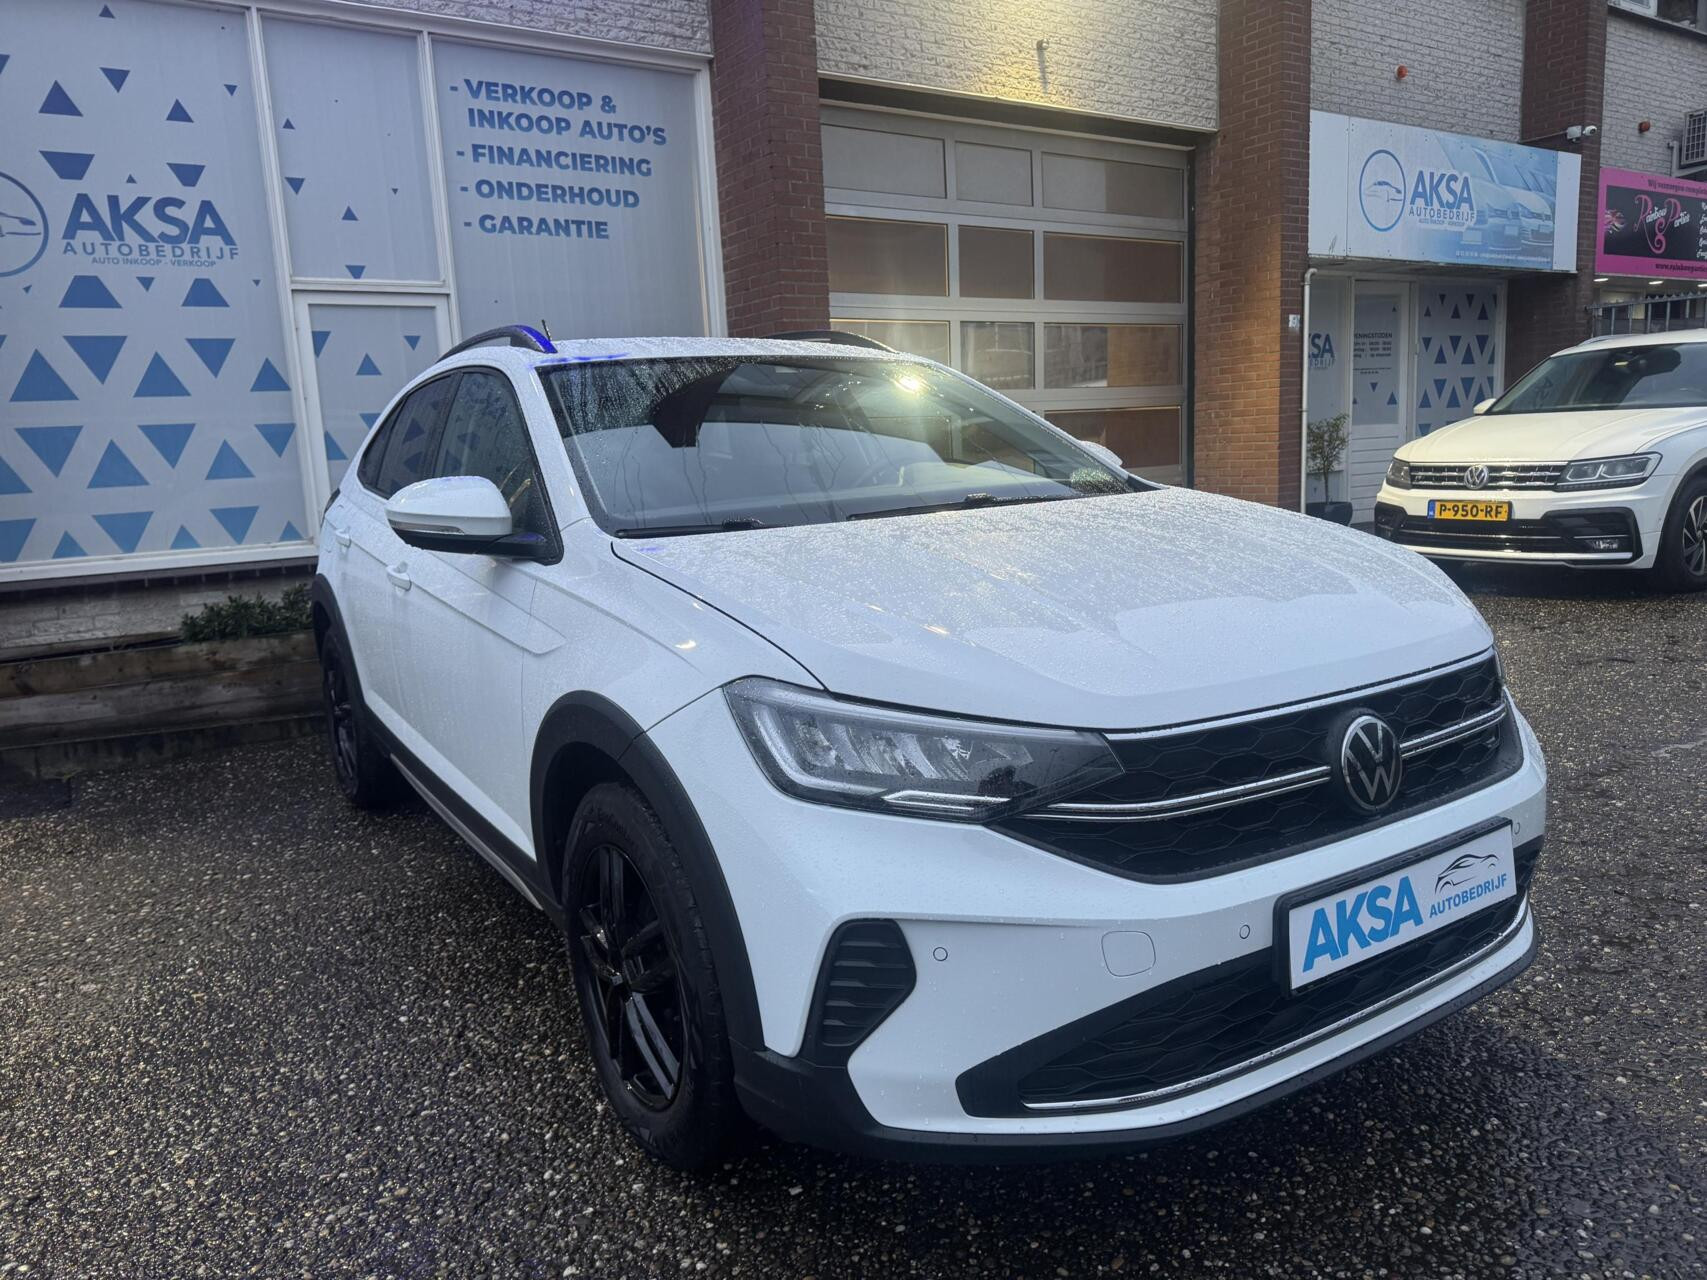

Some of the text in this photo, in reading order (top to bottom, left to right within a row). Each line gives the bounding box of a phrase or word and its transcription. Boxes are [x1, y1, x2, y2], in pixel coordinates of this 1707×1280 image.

[463, 78, 593, 111] VERKOOP
[600, 95, 616, 114] &
[467, 107, 571, 136] INKOOP
[471, 143, 652, 177] FINANCIERING
[475, 179, 640, 208] ONDERHOUD
[1409, 170, 1475, 211] AKSA
[62, 192, 238, 246] AKSA
[478, 213, 610, 240] GARANTIE
[1408, 207, 1476, 222] AUTOBEDRIJF
[62, 241, 239, 260] AUTOBEDRIJF
[91, 256, 120, 265] AUTO
[122, 257, 162, 266] INKOOP
[170, 258, 216, 268] VERKOOP
[1307, 332, 1335, 358] SA
[1439, 504, 1503, 519] P-950-RF
[1302, 872, 1508, 973] AKSA AUTOBEDRIJF
